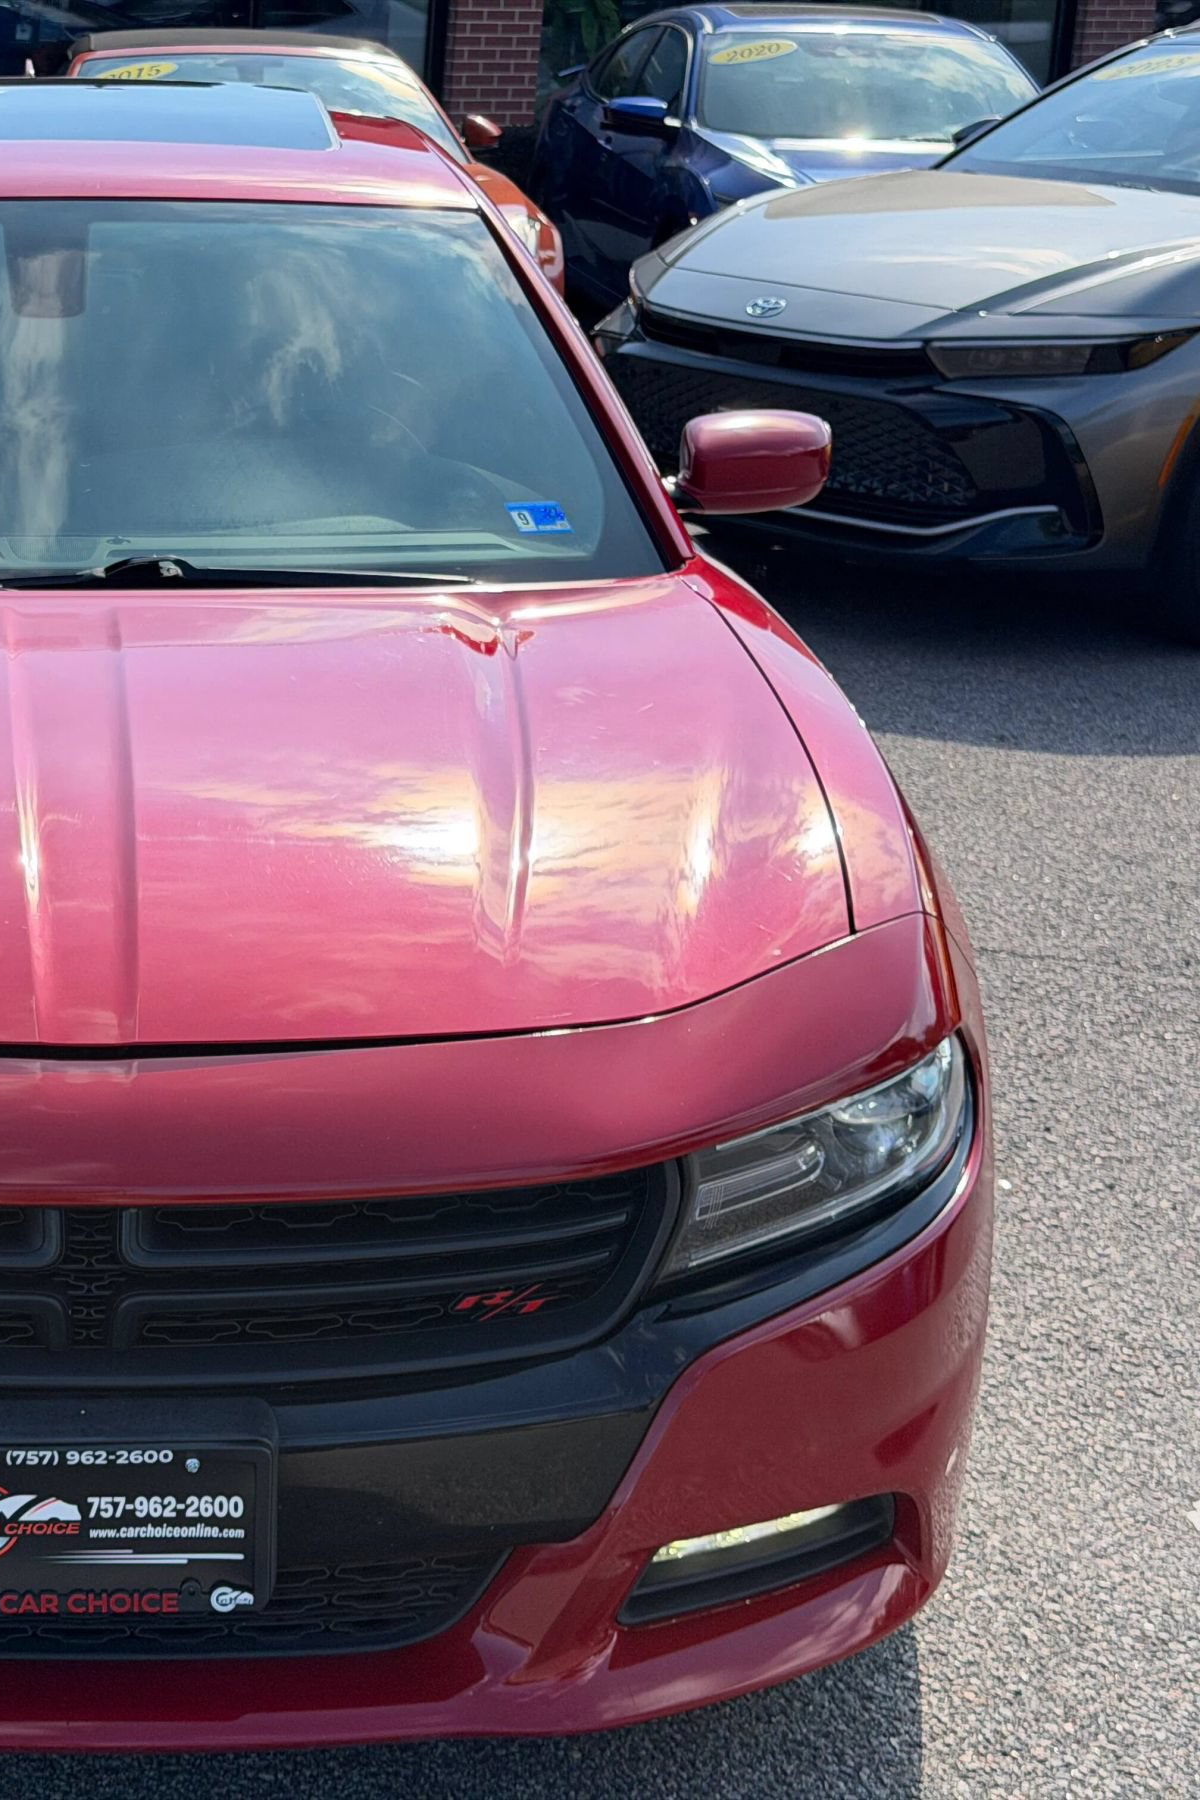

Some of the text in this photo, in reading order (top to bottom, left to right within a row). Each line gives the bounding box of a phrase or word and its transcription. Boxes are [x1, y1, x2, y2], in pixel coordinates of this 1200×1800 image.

[726, 43, 781, 62] 2020
[453, 1283, 558, 1321] R/T
[6, 1449, 173, 1466] (757) 962-2600
[87, 1495, 245, 1518] 757-962-2600
[4, 1522, 80, 1535] CHOICE
[89, 1523, 245, 1539] www.carchoiceonline.com
[0, 1592, 179, 1615] CAR CHOICE
